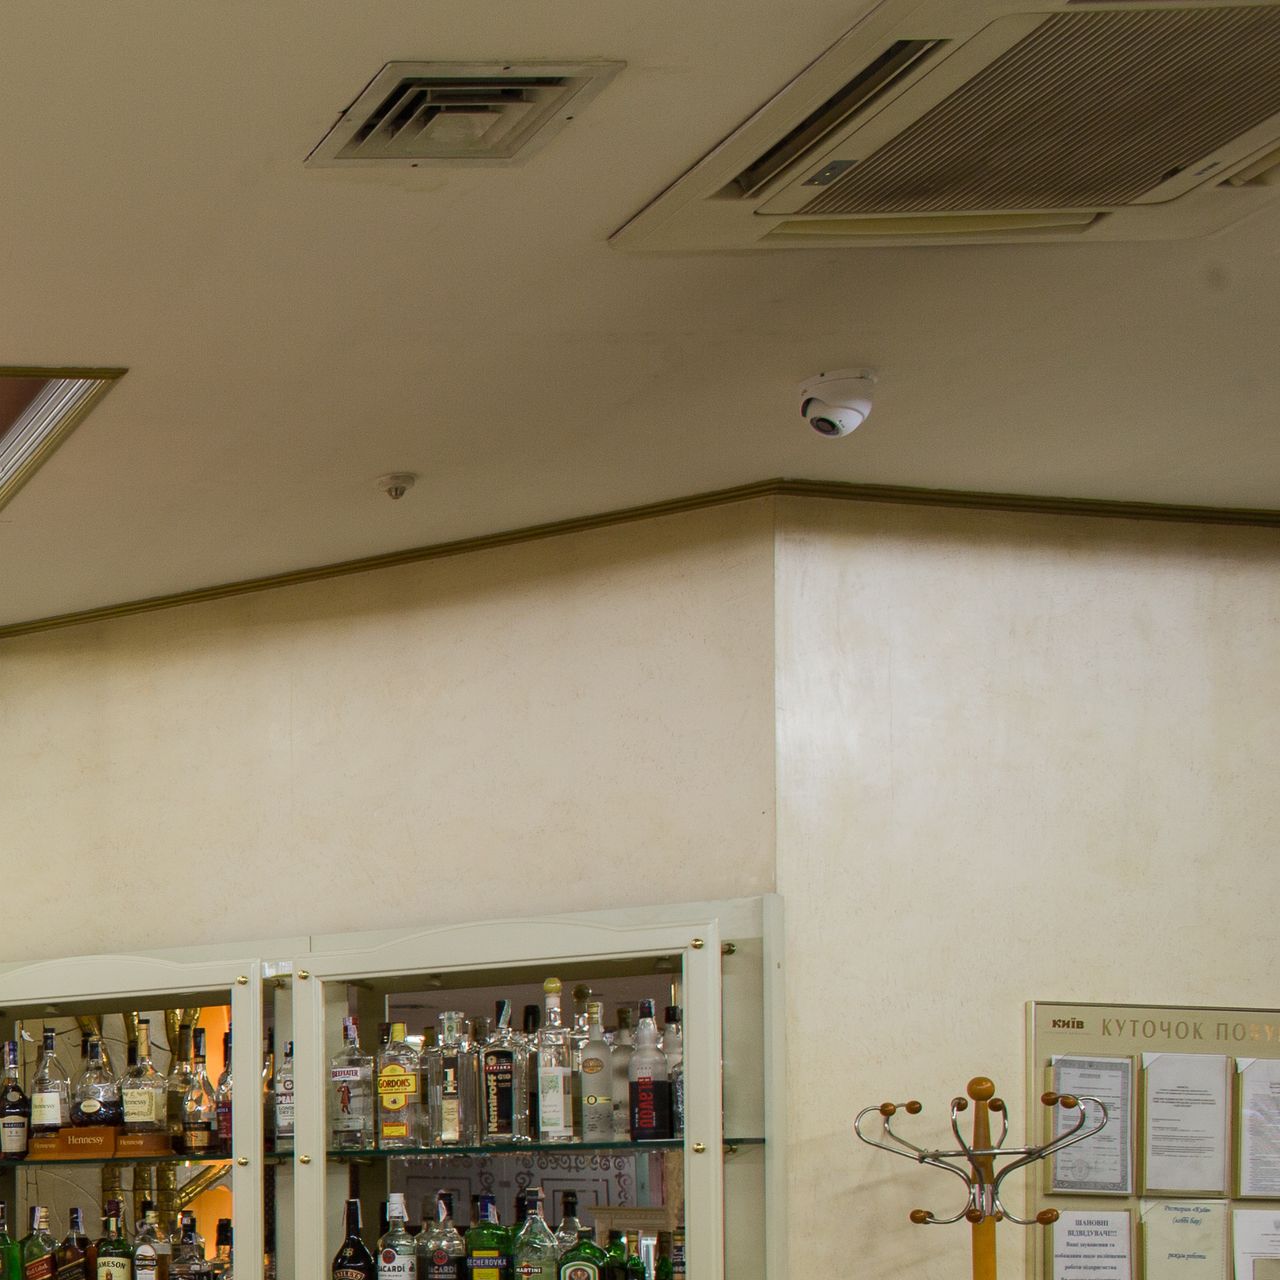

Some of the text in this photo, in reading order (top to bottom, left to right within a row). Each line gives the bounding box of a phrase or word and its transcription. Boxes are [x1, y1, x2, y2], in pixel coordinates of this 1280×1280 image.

[1101, 1018, 1203, 1041] КУТОЧОК
[332, 1070, 358, 1078] BEEFEATER
[378, 1078, 411, 1088] GORDON'S
[68, 1135, 104, 1146] Hennessy
